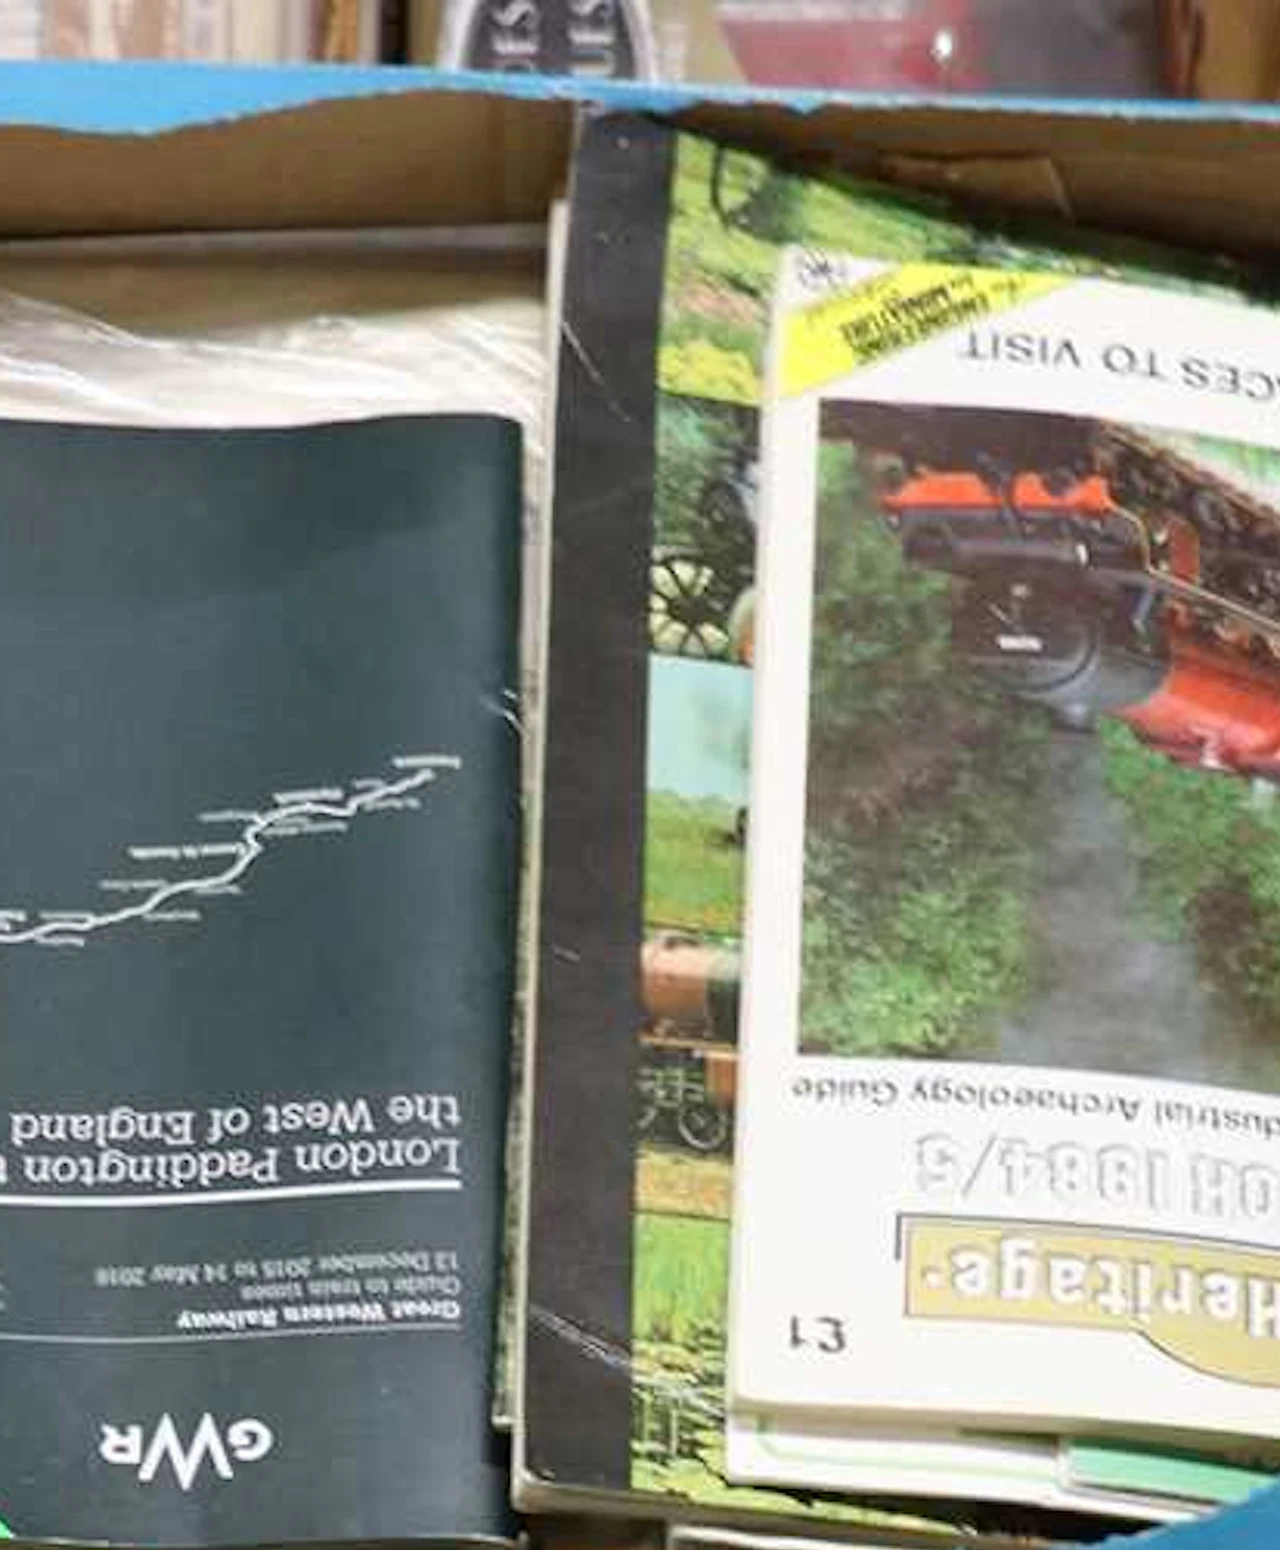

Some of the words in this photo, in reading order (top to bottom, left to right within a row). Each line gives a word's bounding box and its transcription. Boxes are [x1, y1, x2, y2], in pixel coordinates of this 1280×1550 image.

[957, 330, 1083, 372] VISIT
[1100, 343, 1160, 380] TO
[386, 1092, 461, 1125] the
[792, 1075, 898, 1107] Guide
[908, 1076, 1140, 1125] Archaeology
[9, 1106, 195, 1149] England
[203, 1104, 253, 1147] of
[262, 1098, 373, 1137] West
[23, 1146, 279, 1189] Paddington
[294, 1136, 462, 1175] London
[914, 1132, 1168, 1203] 1984/5
[175, 1303, 279, 1331] Railway
[284, 1302, 387, 1325] Western
[391, 1299, 461, 1321] Great
[785, 1314, 848, 1356] £1
[98, 1411, 273, 1492] GWR
